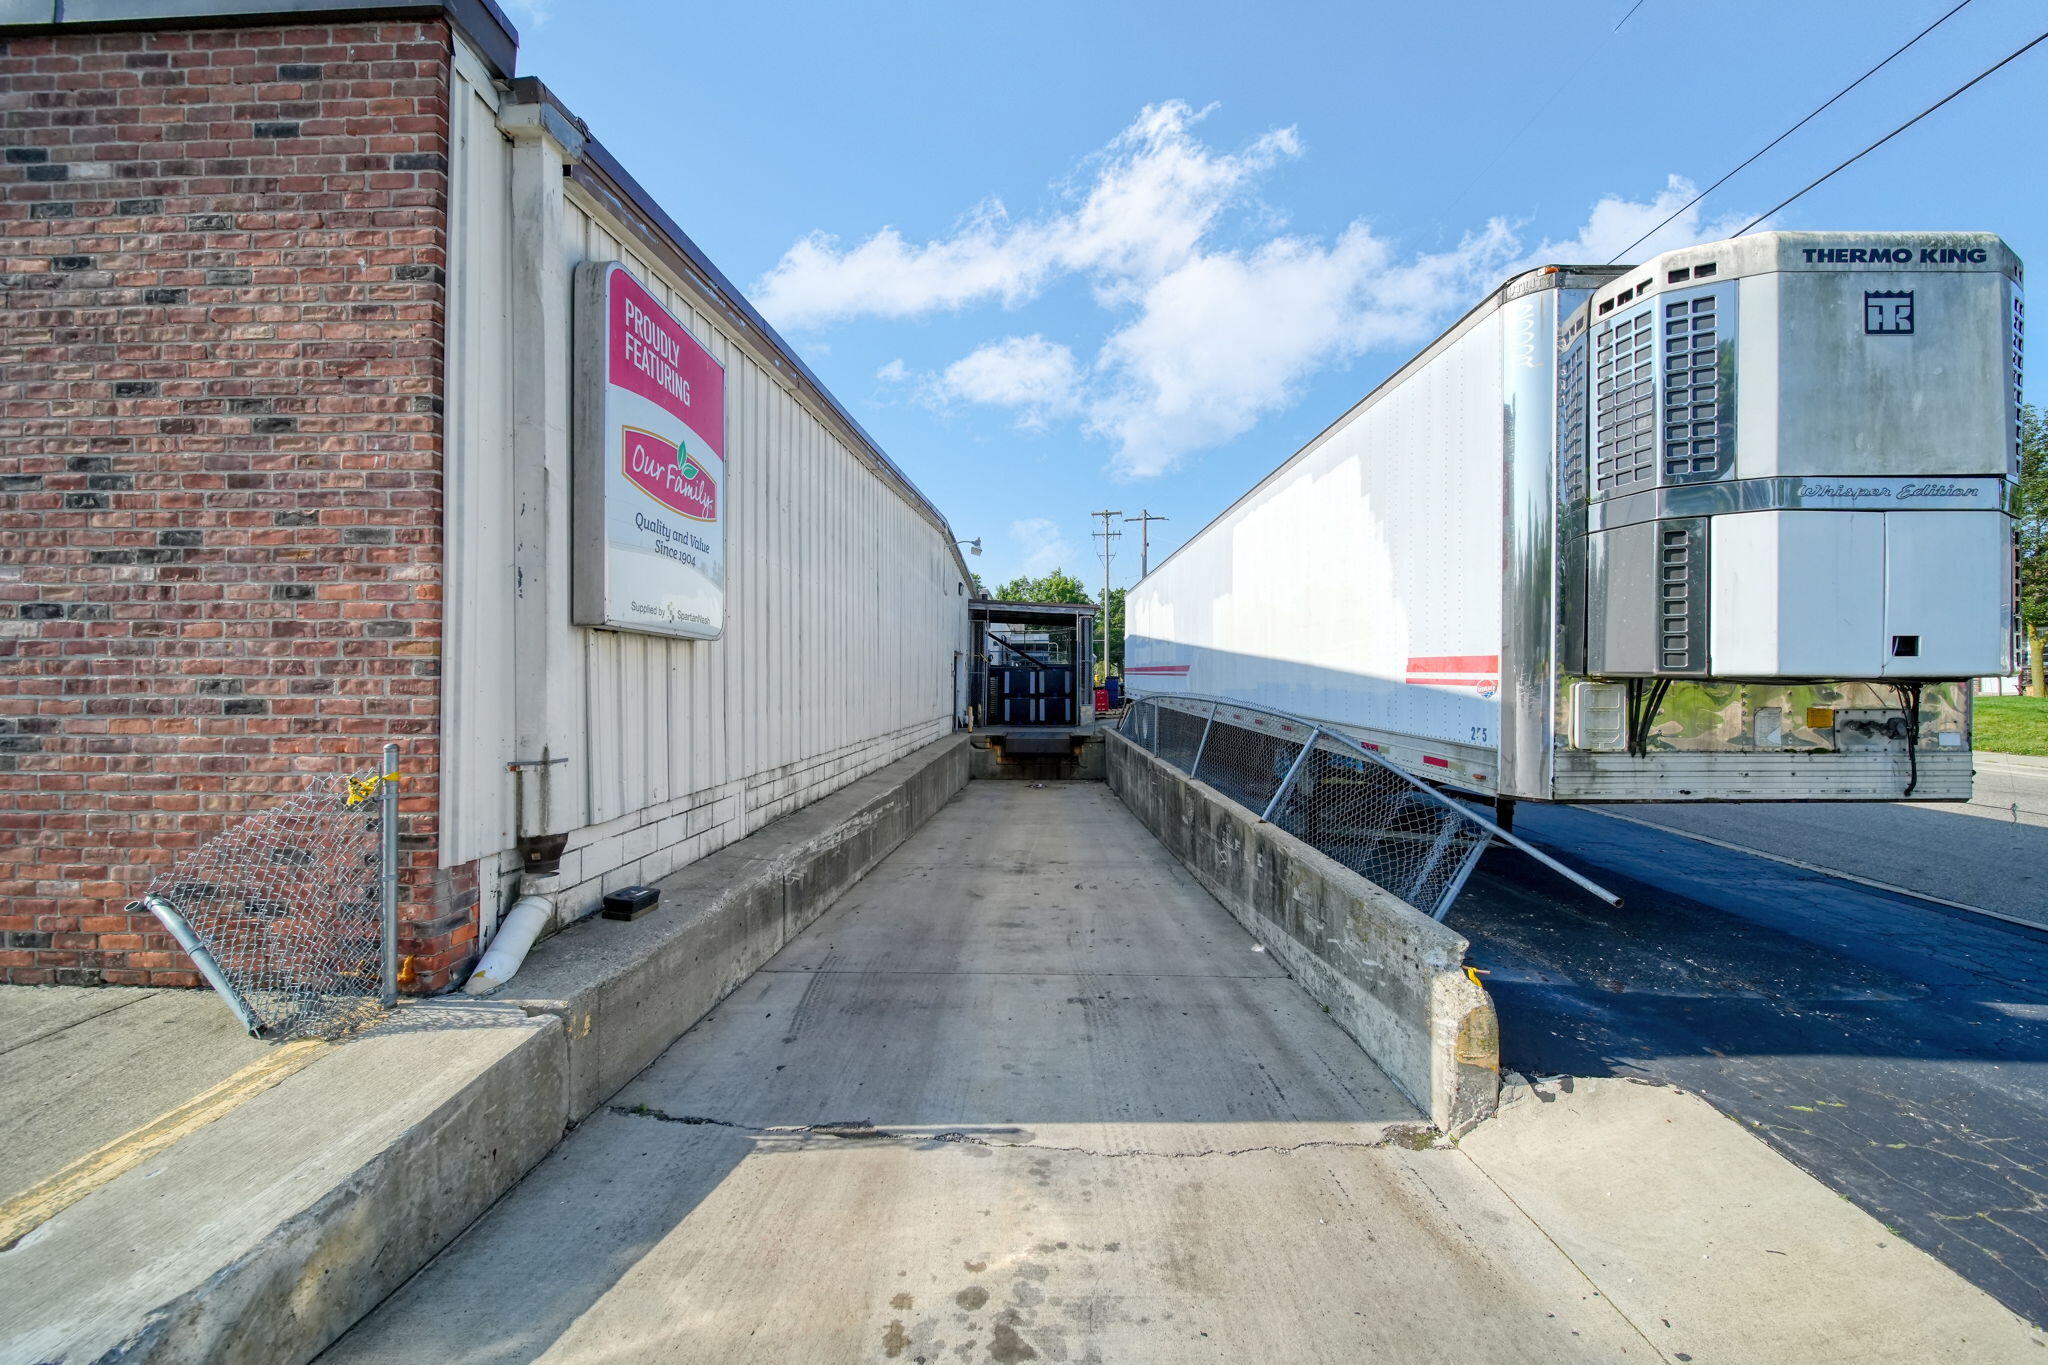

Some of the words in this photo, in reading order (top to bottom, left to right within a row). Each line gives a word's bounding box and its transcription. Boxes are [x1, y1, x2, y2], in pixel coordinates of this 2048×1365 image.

[1802, 248, 1913, 263] THERMO
[1919, 248, 1987, 263] KING
[625, 298, 680, 369] PROUDLY
[625, 331, 691, 408] FEATURING
[632, 444, 666, 480] Our
[666, 463, 714, 519] Family
[1798, 484, 1892, 501] Whisper
[1896, 483, 1980, 500] Edition
[635, 512, 671, 542] Quality
[672, 530, 688, 546] and
[689, 534, 710, 554] Value
[654, 540, 678, 560] Since
[678, 550, 696, 567] 1904
[631, 600, 657, 616] Supplied
[658, 606, 666, 619] by
[677, 609, 711, 625] SpartanNash
